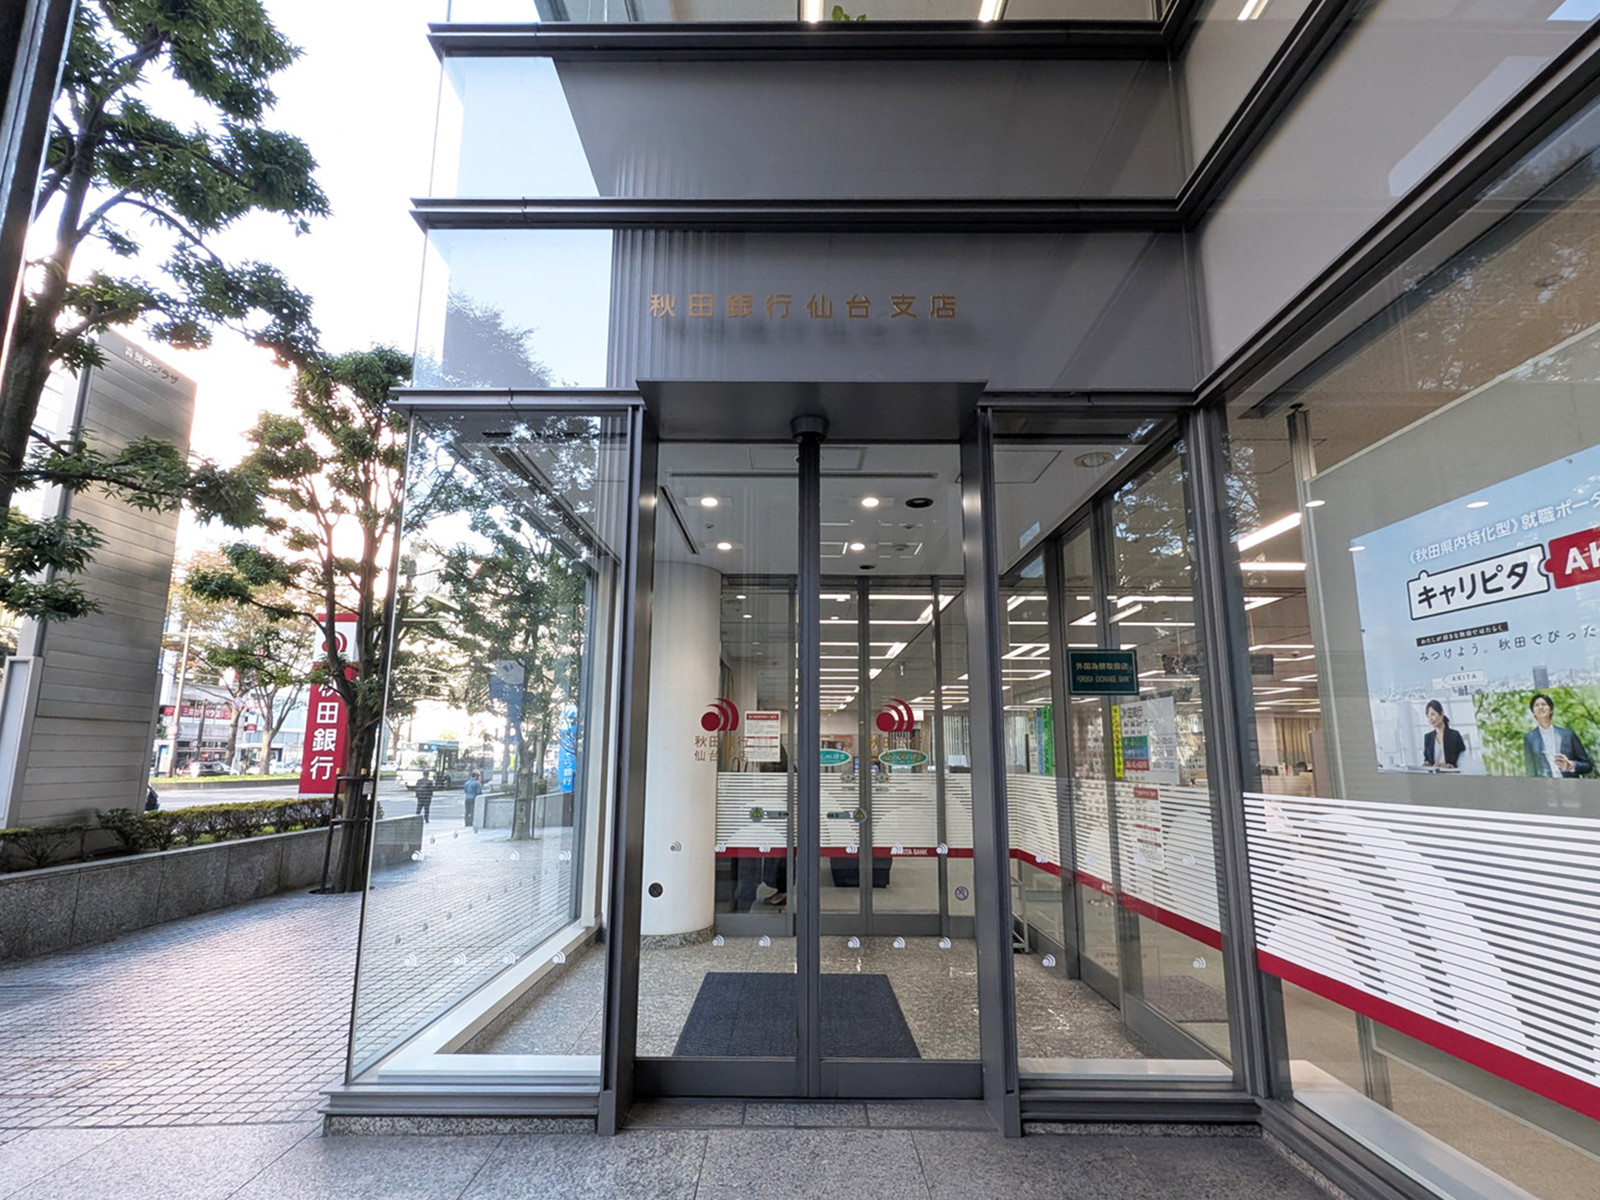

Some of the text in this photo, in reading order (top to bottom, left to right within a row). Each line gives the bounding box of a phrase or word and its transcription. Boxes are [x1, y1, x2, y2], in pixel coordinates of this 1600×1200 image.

[649, 293, 956, 319] 秋田銀行仙台支店
[1417, 561, 1528, 609] キャリピタ
[1451, 673, 1477, 682] AKITA
